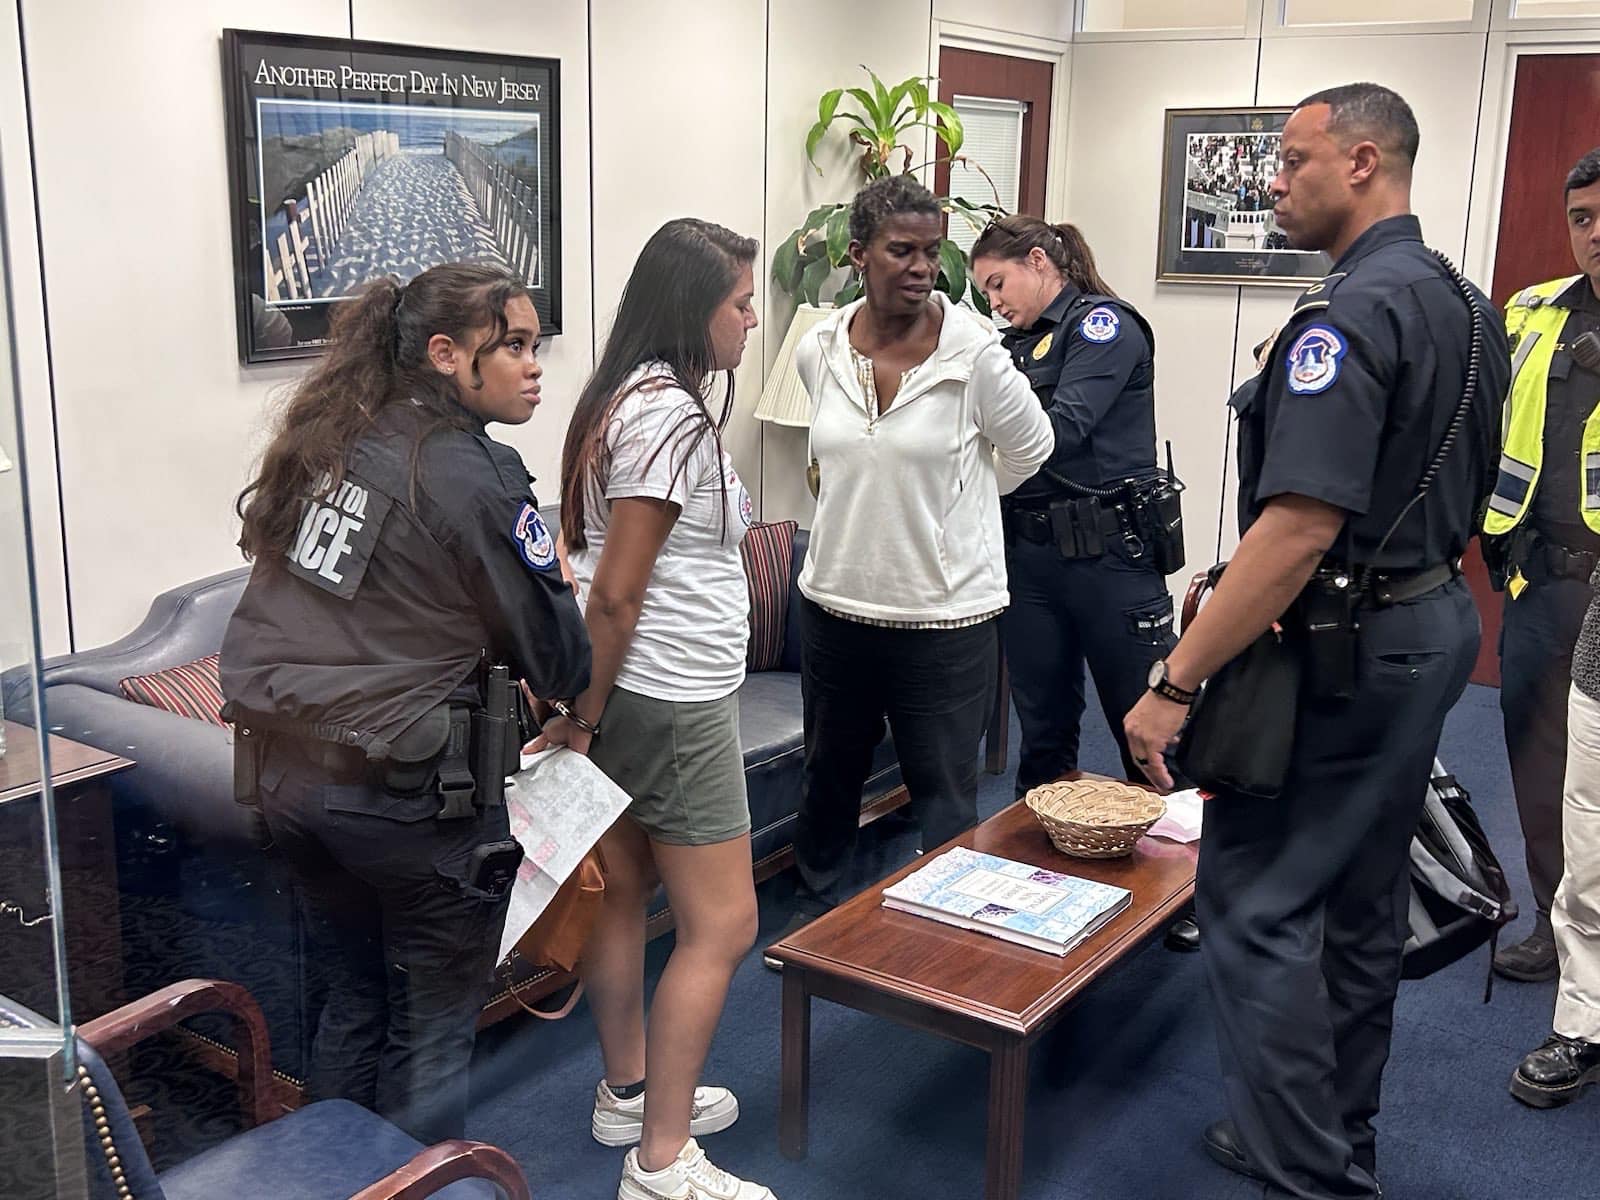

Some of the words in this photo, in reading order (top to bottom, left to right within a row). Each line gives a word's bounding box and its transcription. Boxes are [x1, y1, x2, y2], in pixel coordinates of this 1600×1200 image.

[254, 58, 338, 89] ANOTHER
[340, 65, 407, 93] PERFECT
[409, 70, 439, 95] DAY
[441, 72, 458, 96] IN
[461, 74, 497, 99] NEW
[497, 77, 541, 104] JERSEY
